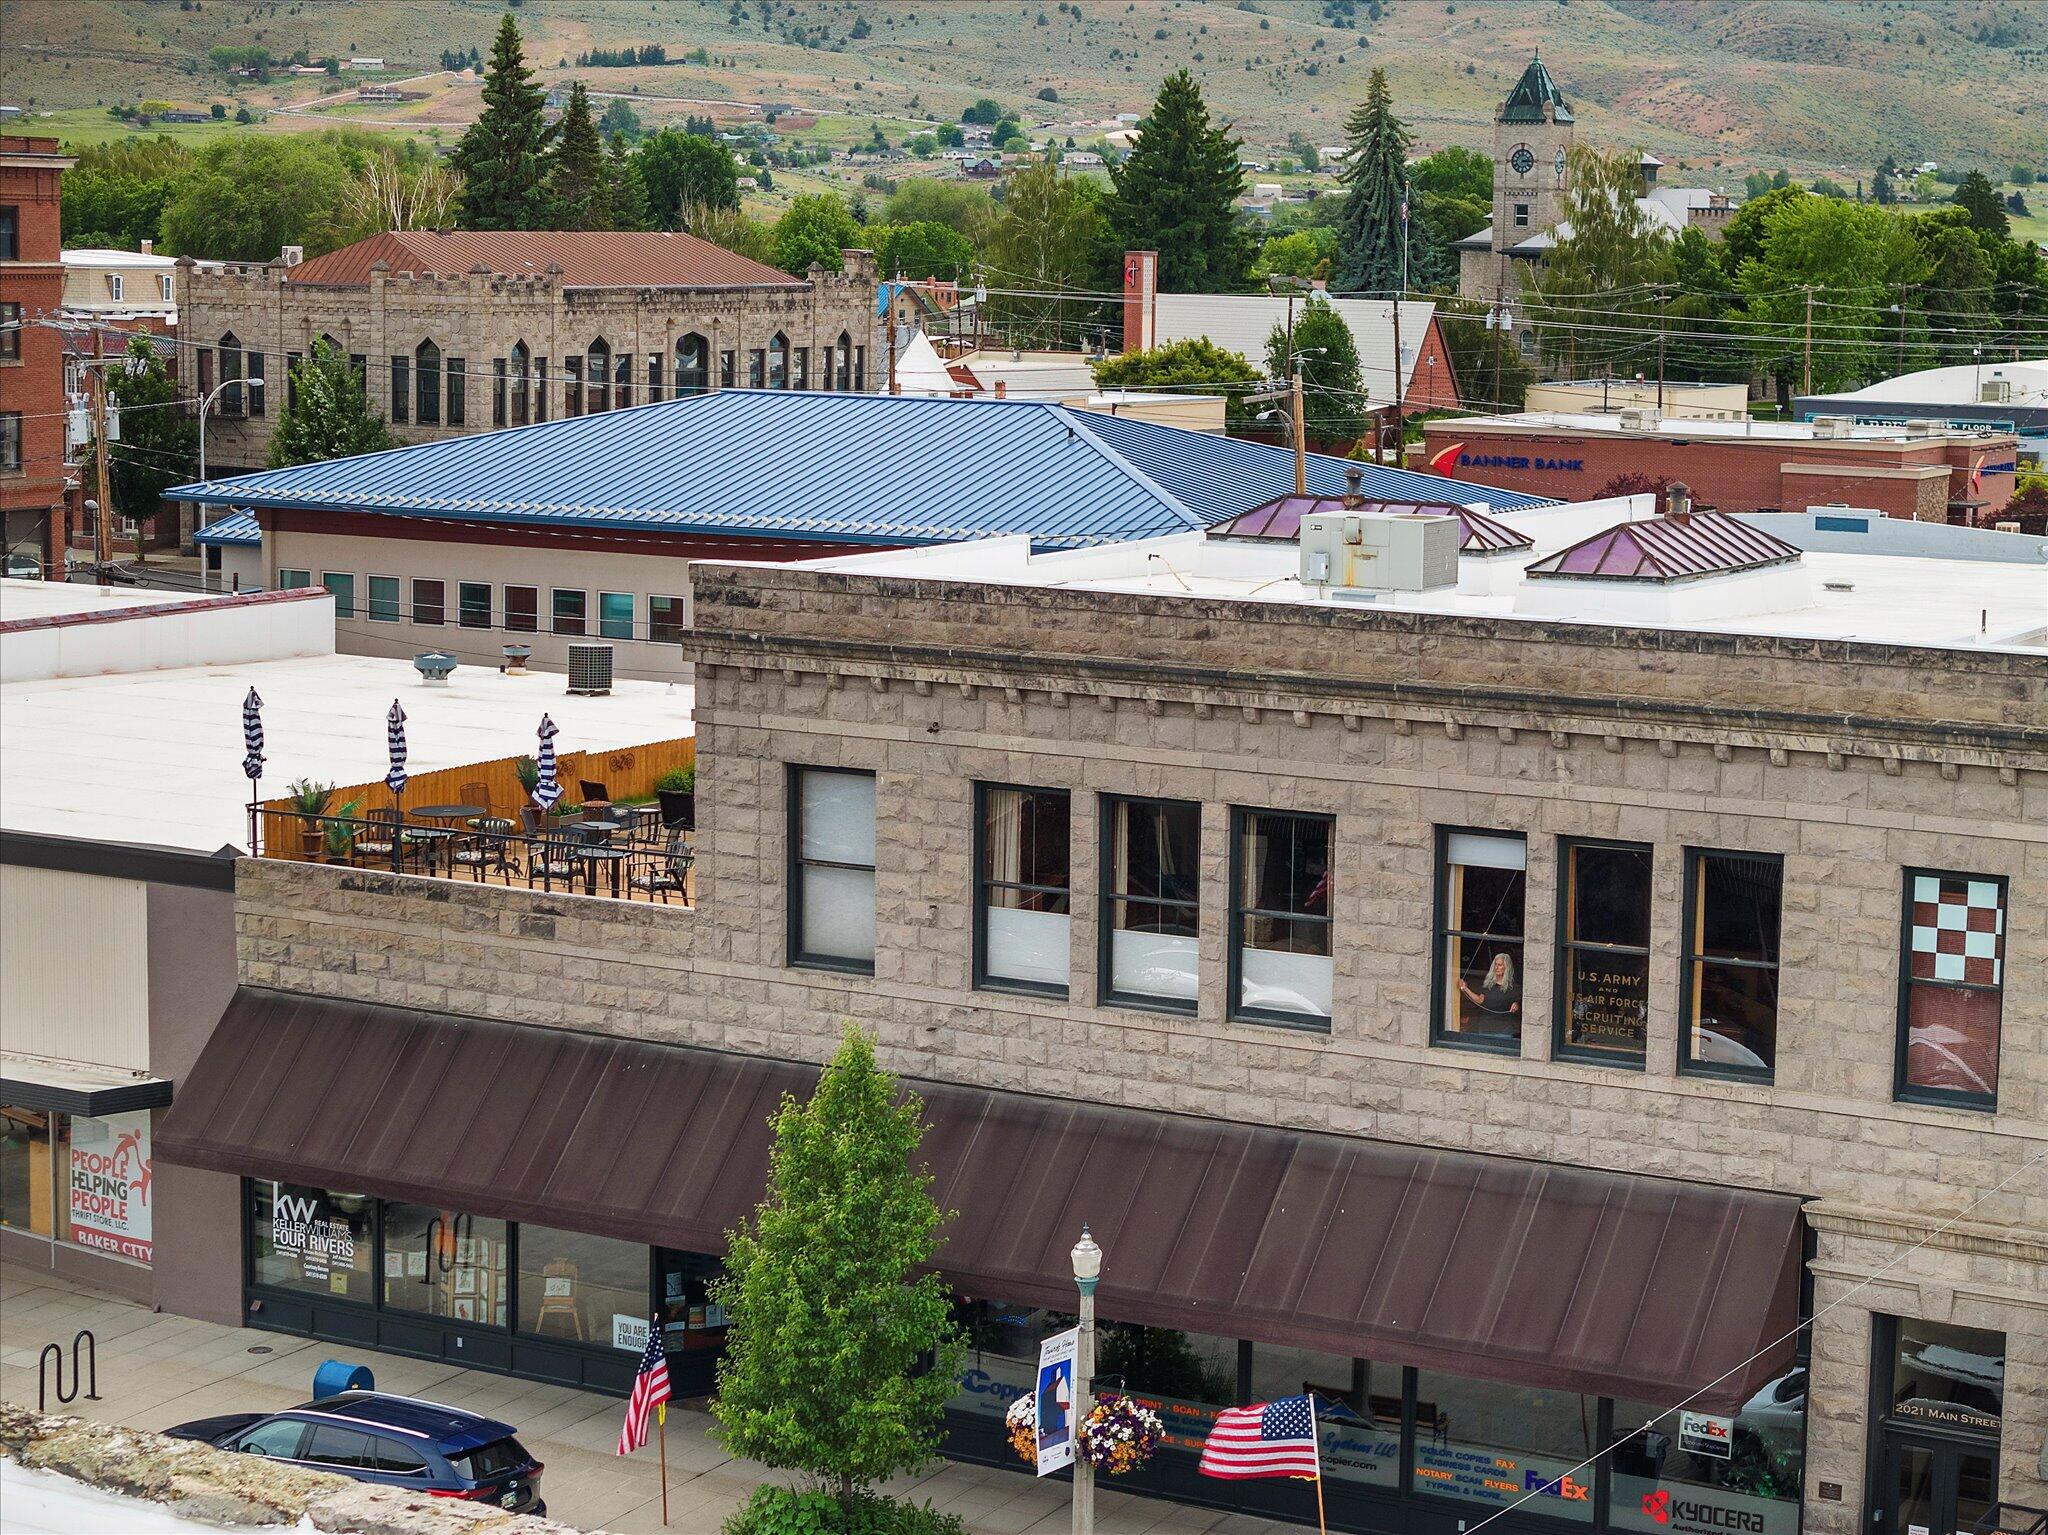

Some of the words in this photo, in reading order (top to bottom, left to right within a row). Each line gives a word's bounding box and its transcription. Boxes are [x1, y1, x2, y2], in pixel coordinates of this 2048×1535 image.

[1962, 424, 1992, 432] FLOOR
[1460, 454, 1529, 470] BANNER
[1535, 457, 1583, 471] BANK
[1603, 973, 1641, 987] ARMY
[1598, 986, 1619, 994] AND
[1587, 994, 1605, 1005] AIR
[1609, 997, 1646, 1009] FORCE
[1574, 1011, 1645, 1027] ECRUITING
[1581, 1023, 1635, 1038] SERVICE
[71, 1148, 128, 1181] PEOPLE
[71, 1169, 128, 1201] HELPING
[71, 1188, 129, 1221] PEOPLE
[72, 1208, 92, 1221] THRIFT
[314, 1219, 329, 1229] REAL
[329, 1222, 350, 1232] ESTATE
[78, 1230, 120, 1253] BAKER
[122, 1241, 152, 1261] CITY
[273, 1228, 306, 1248] FOUR
[309, 1234, 354, 1257] RIVERS
[618, 1321, 632, 1335] YOU
[633, 1325, 647, 1338] ARE
[618, 1333, 648, 1349] ENOUGH
[1173, 1404, 1200, 1416] SCAN
[1895, 1404, 1924, 1416] 2021
[1684, 1416, 1728, 1438] FedEx
[1320, 1454, 1377, 1471] copier.com
[1420, 1446, 1453, 1458] COLOR
[1455, 1451, 1491, 1465] COPIES
[1495, 1458, 1517, 1470] FAX
[1424, 1456, 1471, 1471] BUSINESS
[1473, 1465, 1507, 1478] CARDS
[1416, 1467, 1454, 1481] NOTARY
[1455, 1474, 1483, 1486] SCAN
[1483, 1478, 1520, 1492] FLYERS
[1425, 1480, 1460, 1493] TYPING
[1525, 1469, 1589, 1502] FedEx
[1672, 1499, 1764, 1533] KYOCERA
